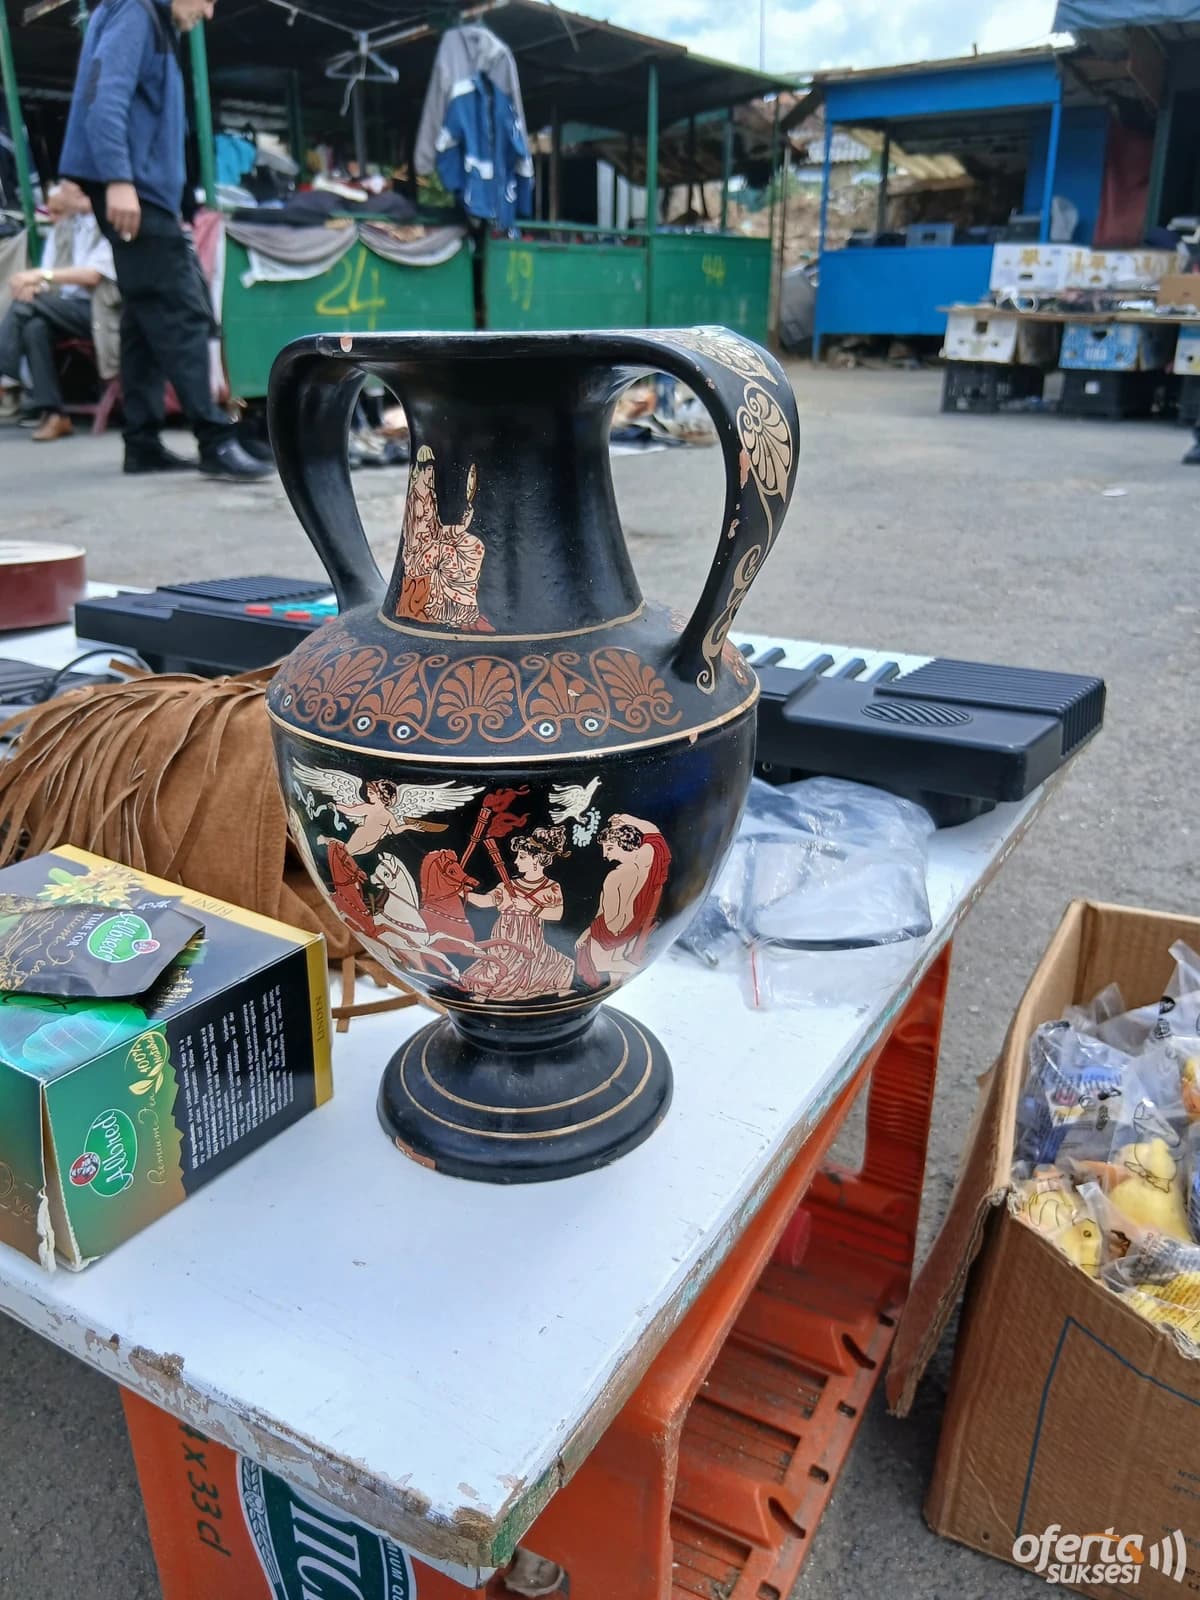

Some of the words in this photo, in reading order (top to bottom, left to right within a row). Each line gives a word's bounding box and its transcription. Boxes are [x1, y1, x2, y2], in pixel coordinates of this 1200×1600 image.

[315, 247, 386, 331] 24
[82, 912, 104, 933] TIME
[66, 930, 88, 947] FOR
[131, 1044, 151, 1073] 100%
[147, 1125, 167, 1185] Premium
